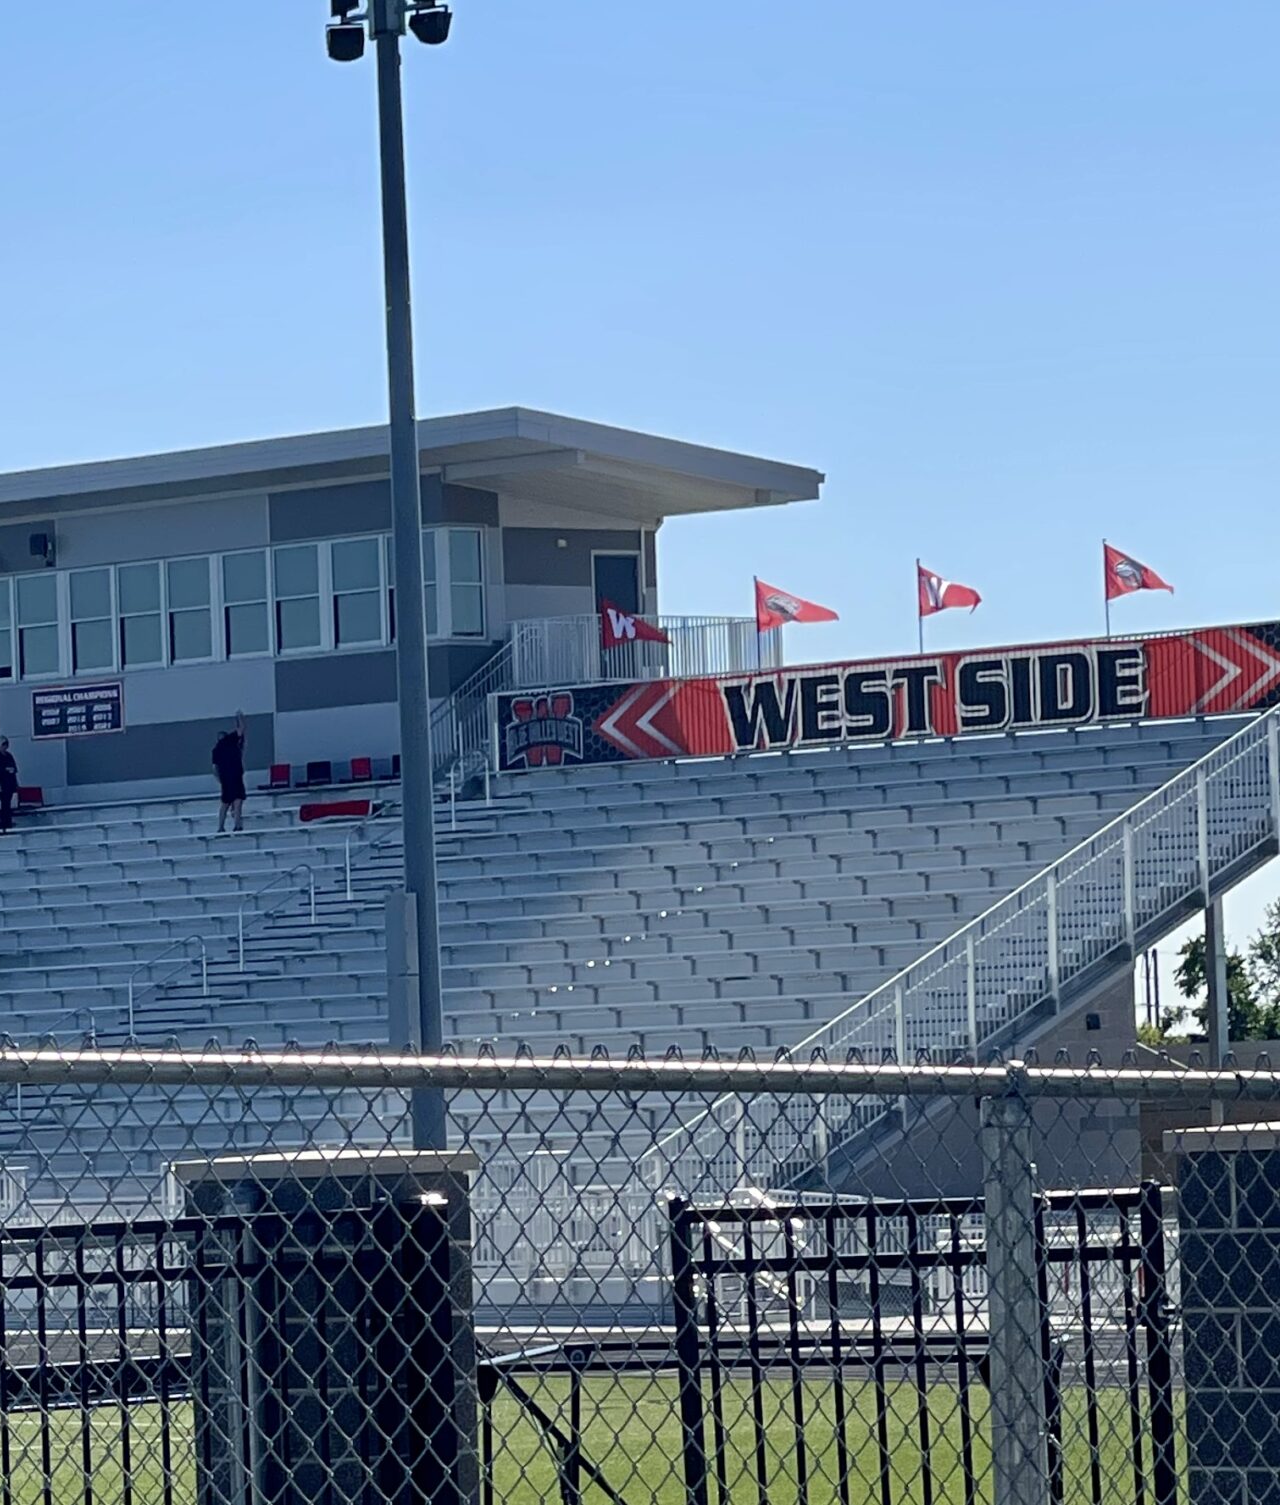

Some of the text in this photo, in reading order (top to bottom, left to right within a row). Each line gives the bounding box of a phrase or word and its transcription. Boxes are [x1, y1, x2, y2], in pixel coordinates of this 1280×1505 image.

[35, 689, 118, 705] REGIONAL CHAMPIONS
[717, 642, 1149, 751] WEST SIDE
